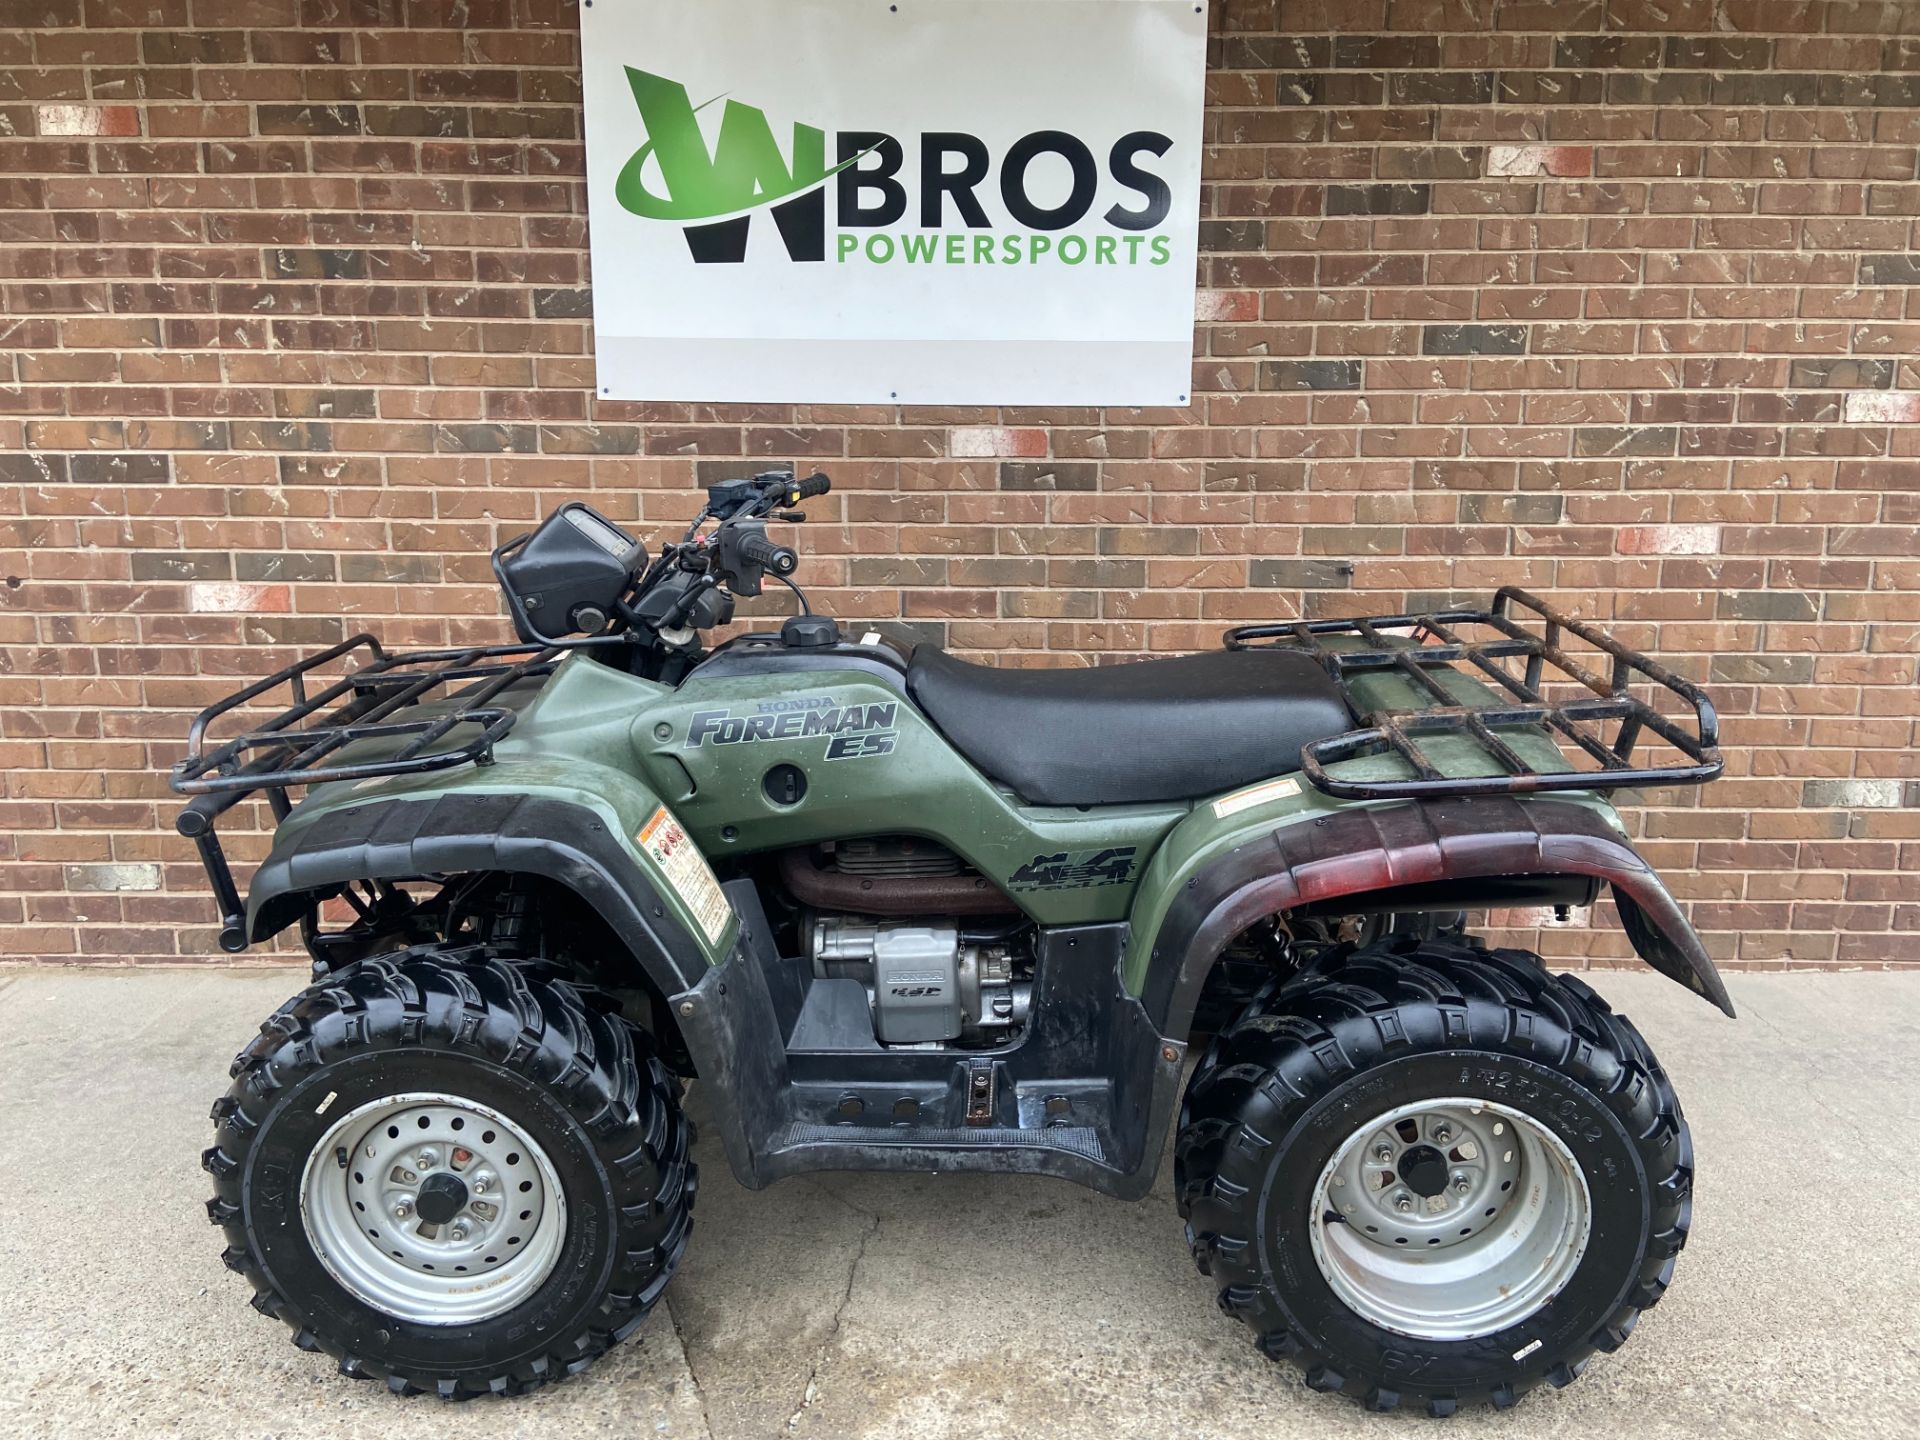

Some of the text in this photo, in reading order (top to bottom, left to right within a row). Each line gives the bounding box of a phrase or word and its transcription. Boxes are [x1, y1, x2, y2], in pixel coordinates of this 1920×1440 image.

[837, 234, 1171, 265] POWERSPORTS
[757, 696, 836, 712] HONDA
[684, 701, 899, 748] FOREMAN
[824, 731, 900, 761] ES
